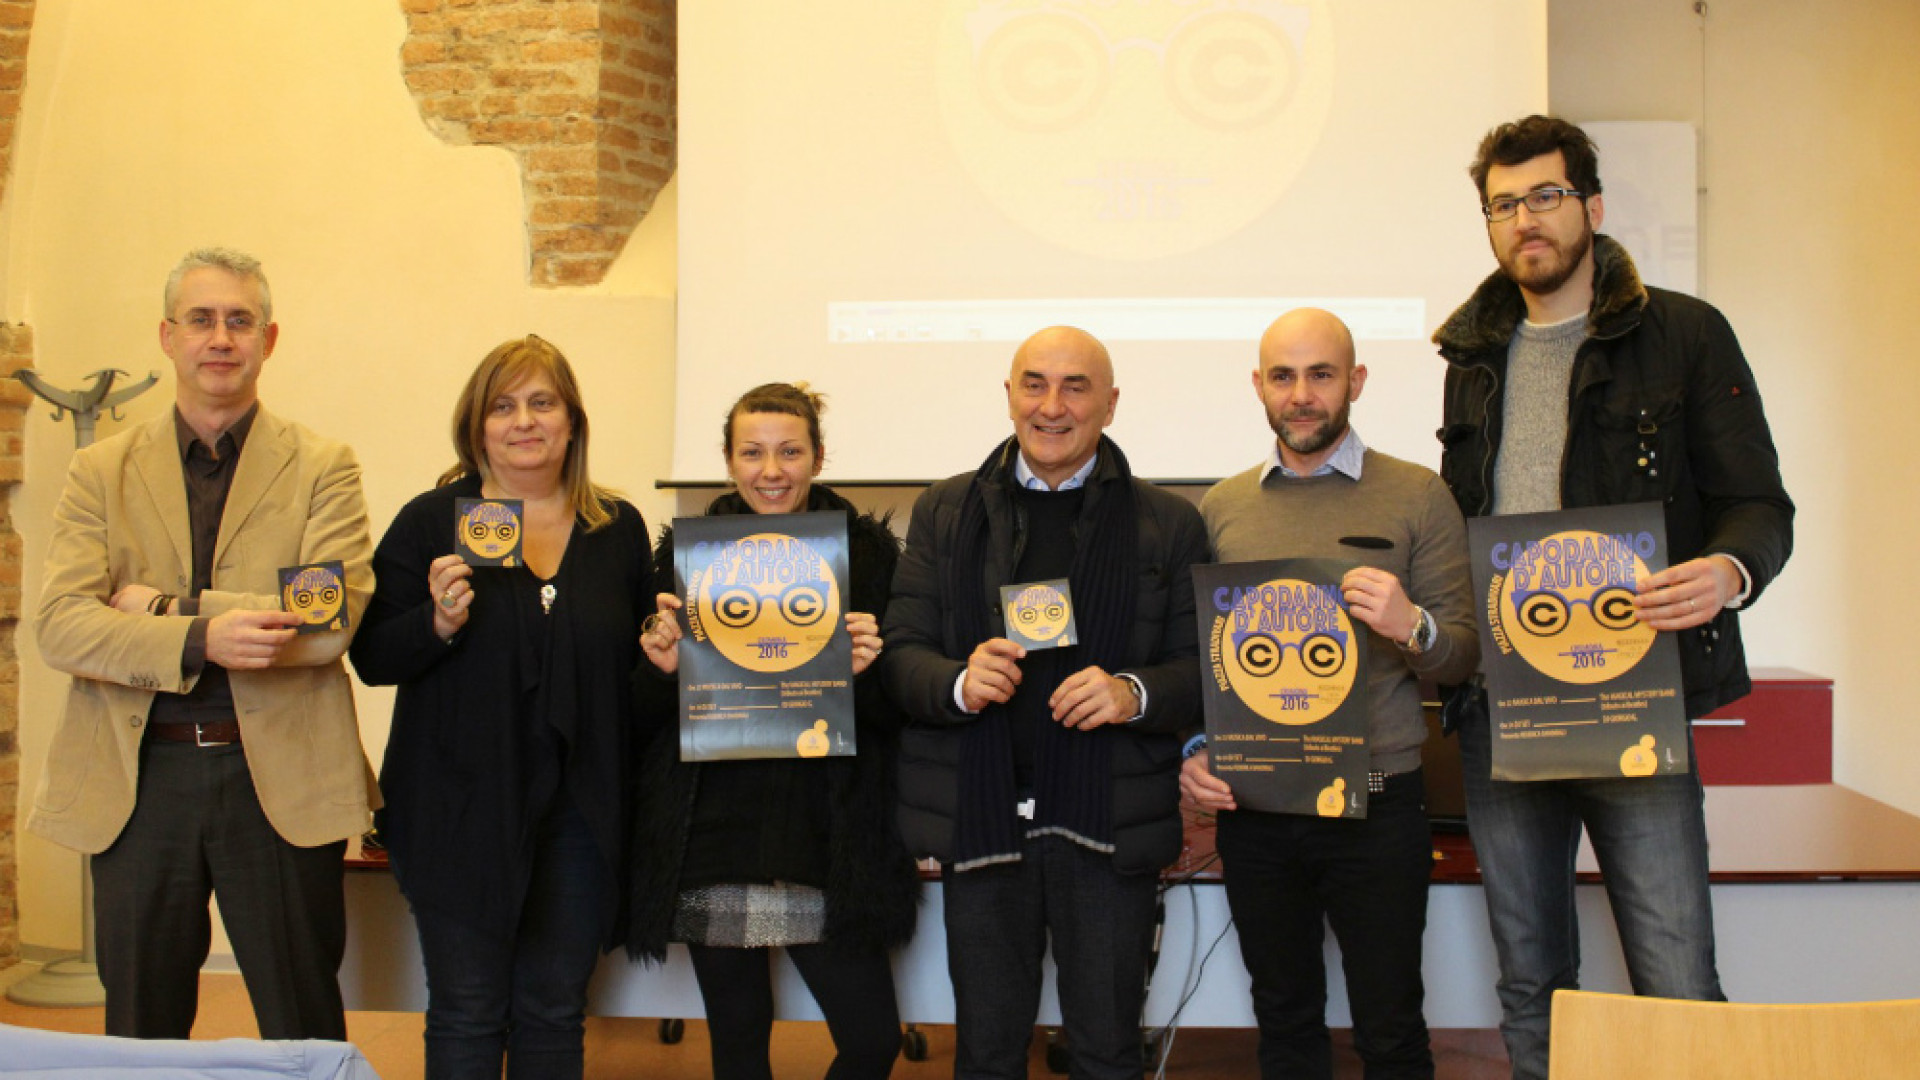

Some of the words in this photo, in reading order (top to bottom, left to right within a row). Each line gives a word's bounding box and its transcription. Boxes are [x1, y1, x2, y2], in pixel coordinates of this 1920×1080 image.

[694, 536, 840, 564] CAPODANNO
[1491, 531, 1656, 570] CAPODANNO
[712, 558, 821, 585] D'AUTORE
[1513, 559, 1637, 591] D'AUTORE
[1234, 607, 1339, 632] D'AUTORE
[758, 644, 788, 658] 2016
[1572, 652, 1606, 668] 2016
[1281, 695, 1310, 710] 2016
